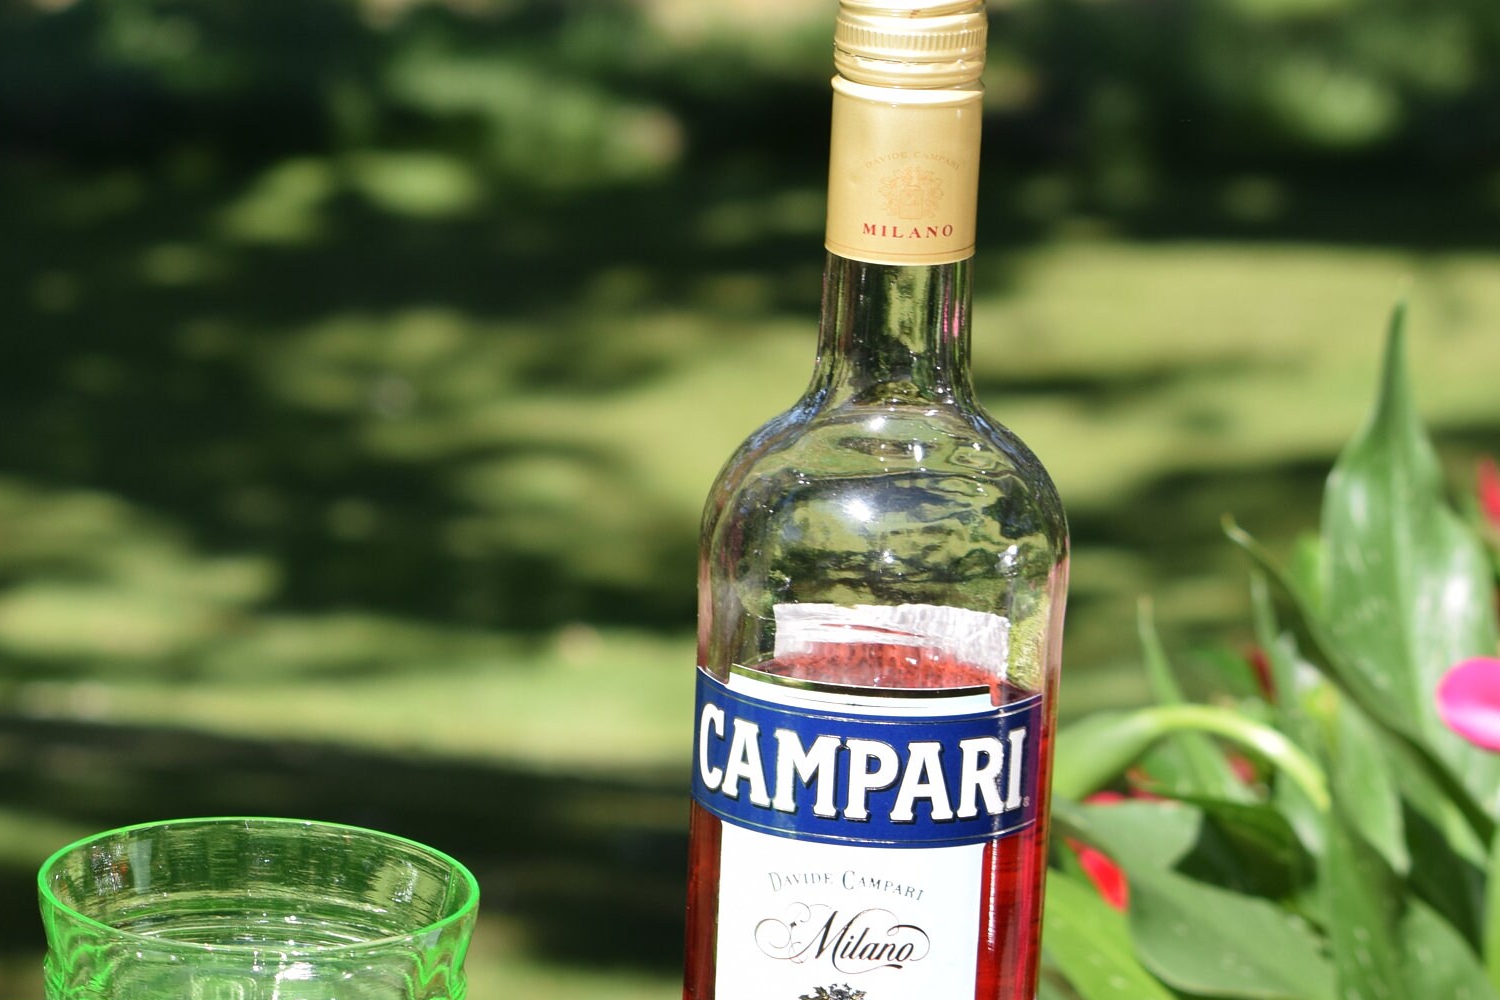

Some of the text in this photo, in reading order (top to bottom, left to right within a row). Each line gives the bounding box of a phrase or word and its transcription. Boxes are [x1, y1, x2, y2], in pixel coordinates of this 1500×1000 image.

[862, 222, 954, 239] MILANO
[699, 702, 1028, 824] CAMPARI
[754, 902, 931, 975] Milano
